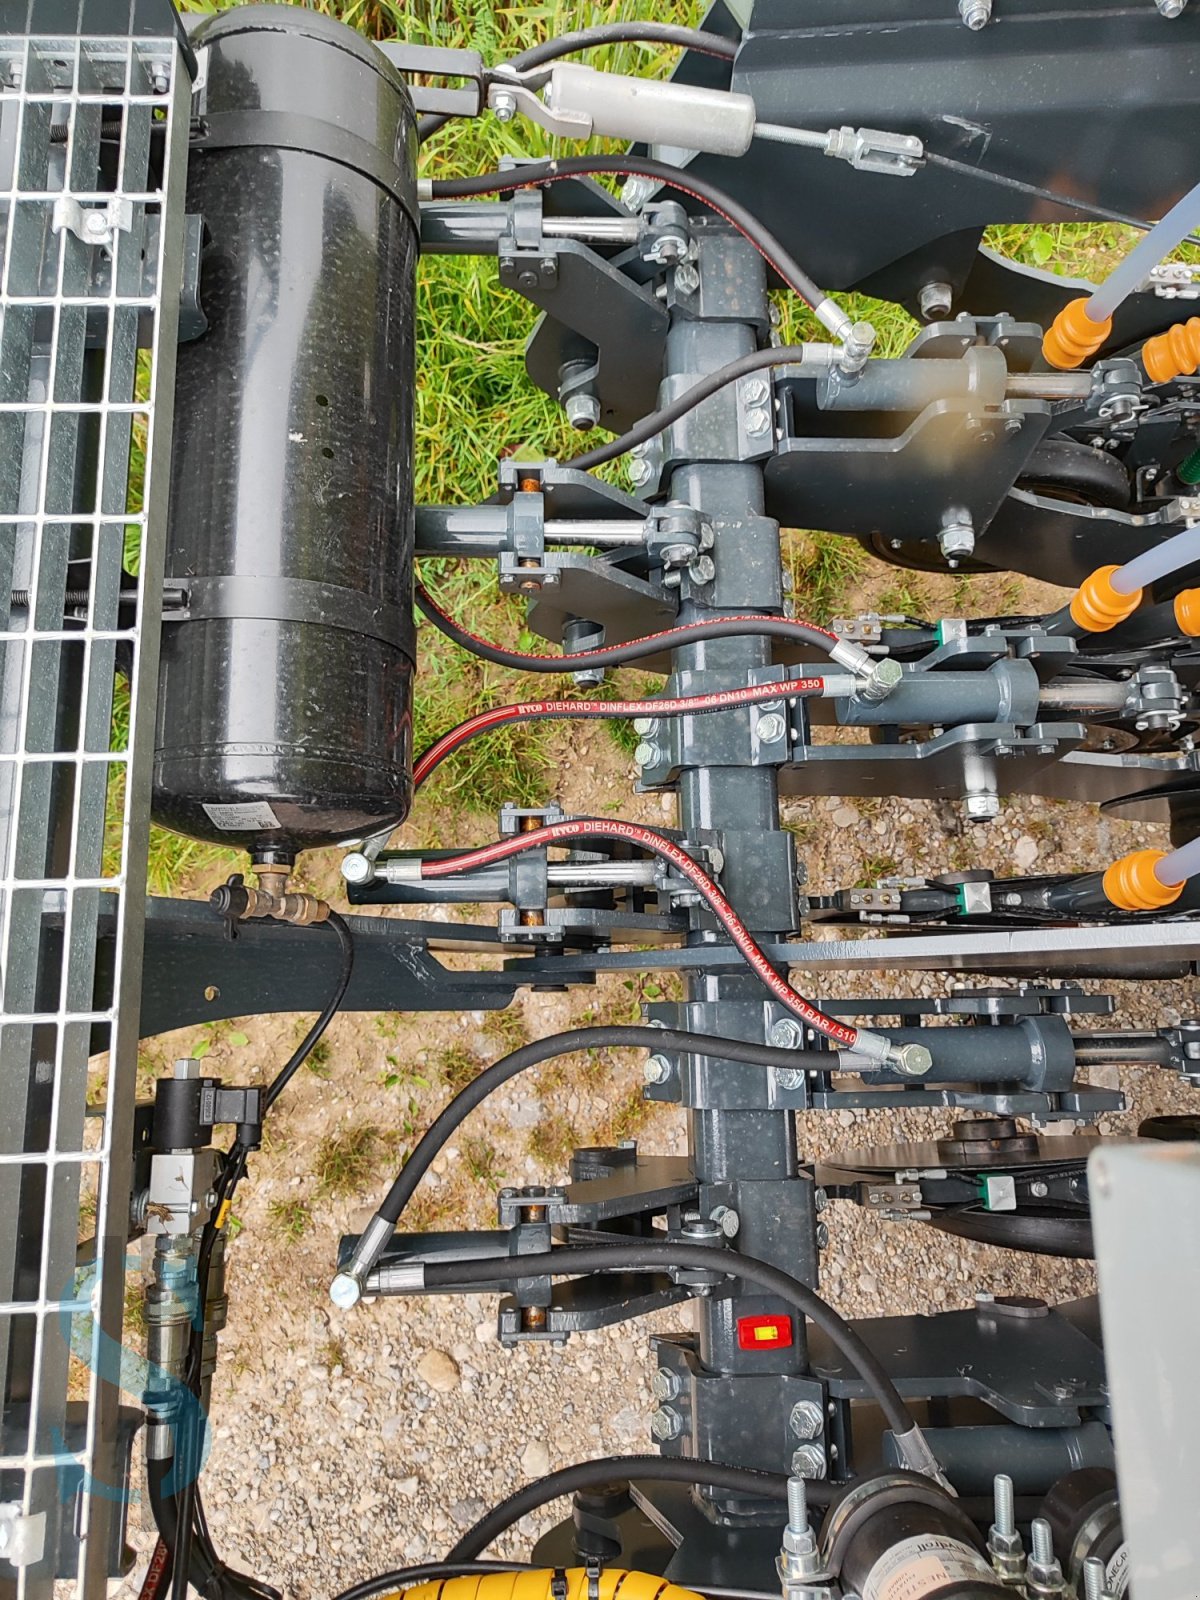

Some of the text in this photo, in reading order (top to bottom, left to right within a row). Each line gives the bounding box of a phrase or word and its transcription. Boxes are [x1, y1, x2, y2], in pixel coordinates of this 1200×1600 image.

[518, 704, 543, 714] RYCO
[600, 702, 642, 712] DINFLEX
[645, 701, 677, 711] DF26D
[719, 690, 747, 704] DN10
[752, 685, 778, 698] MAX
[779, 681, 798, 692] WP
[801, 679, 821, 690] 350
[551, 824, 580, 837] RYCO
[642, 831, 686, 863] DINFLEX
[683, 861, 711, 890] DF26D
[733, 924, 754, 953] DN10
[751, 954, 774, 980] MAX
[770, 977, 788, 996] WP
[786, 994, 806, 1010] 350
[805, 1008, 829, 1030] BAR
[836, 1028, 857, 1043] 510
